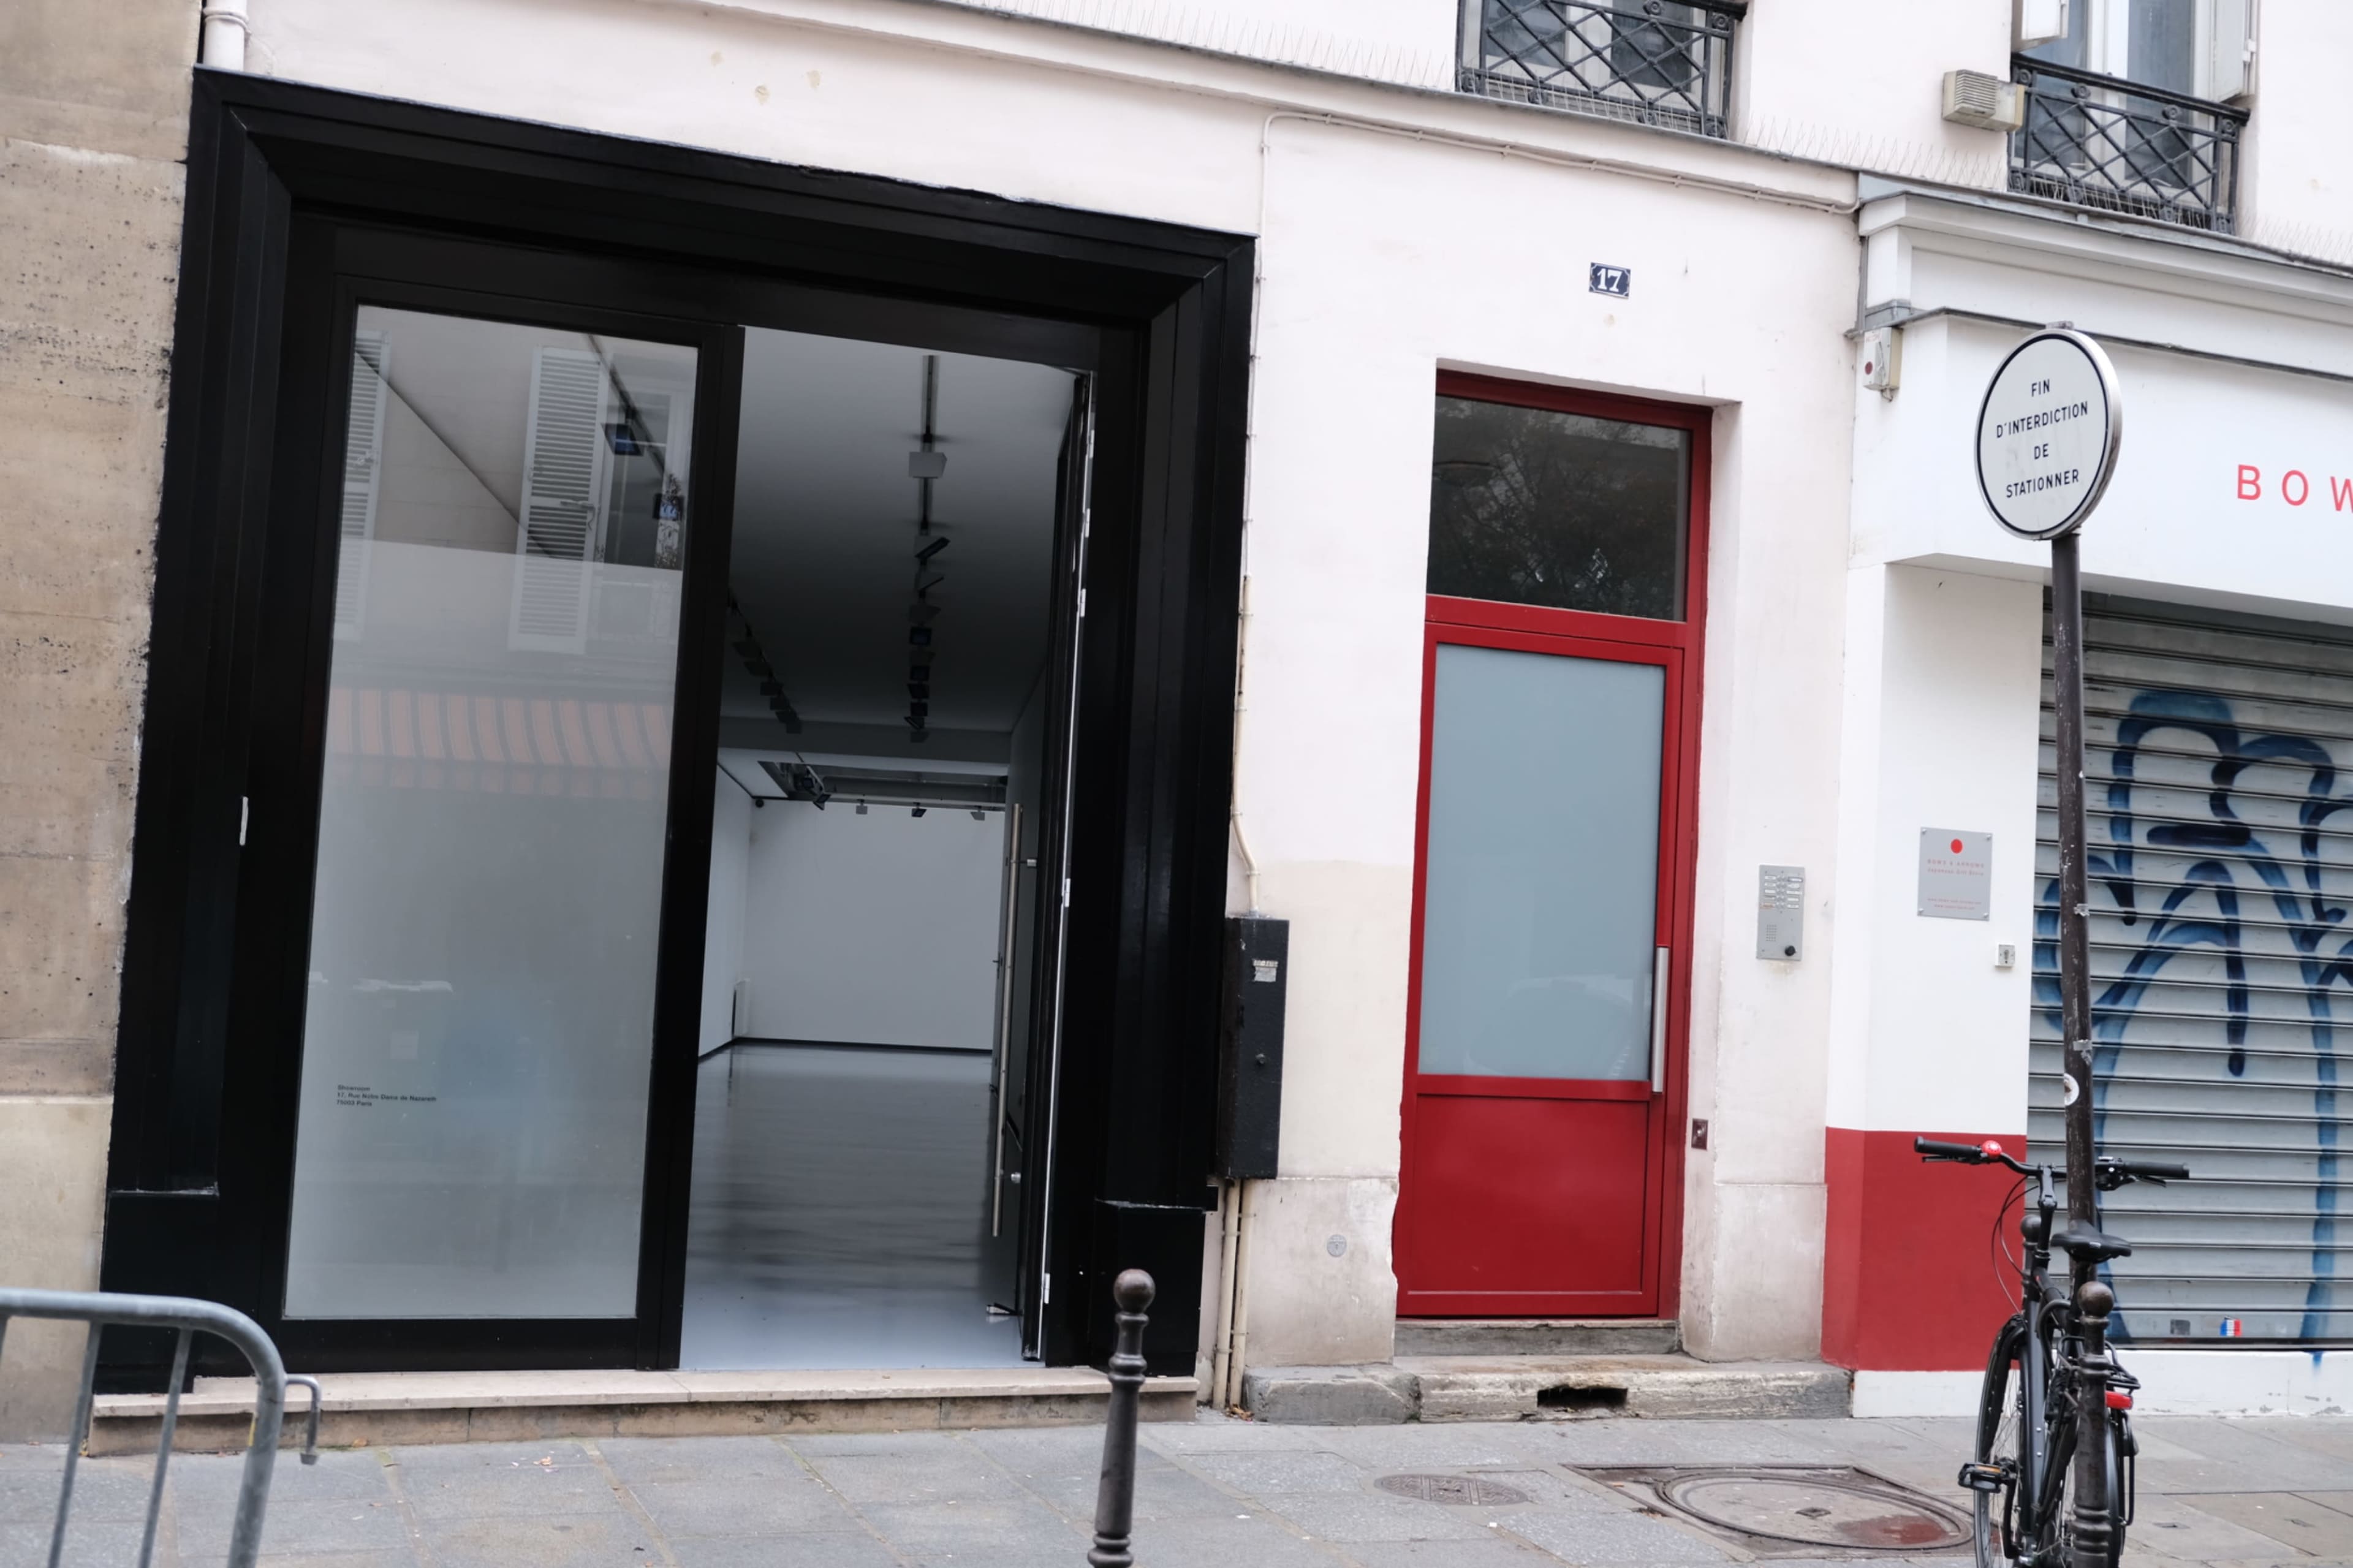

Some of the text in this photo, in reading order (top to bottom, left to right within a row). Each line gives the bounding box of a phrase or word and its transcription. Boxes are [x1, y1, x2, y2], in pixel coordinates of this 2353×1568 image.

[1597, 268, 1623, 292] 17
[2031, 379, 2050, 397] FIN
[1996, 401, 2088, 438] D'INTERDICTION
[2034, 443, 2049, 460] DE
[2006, 469, 2079, 498] STATIONNER
